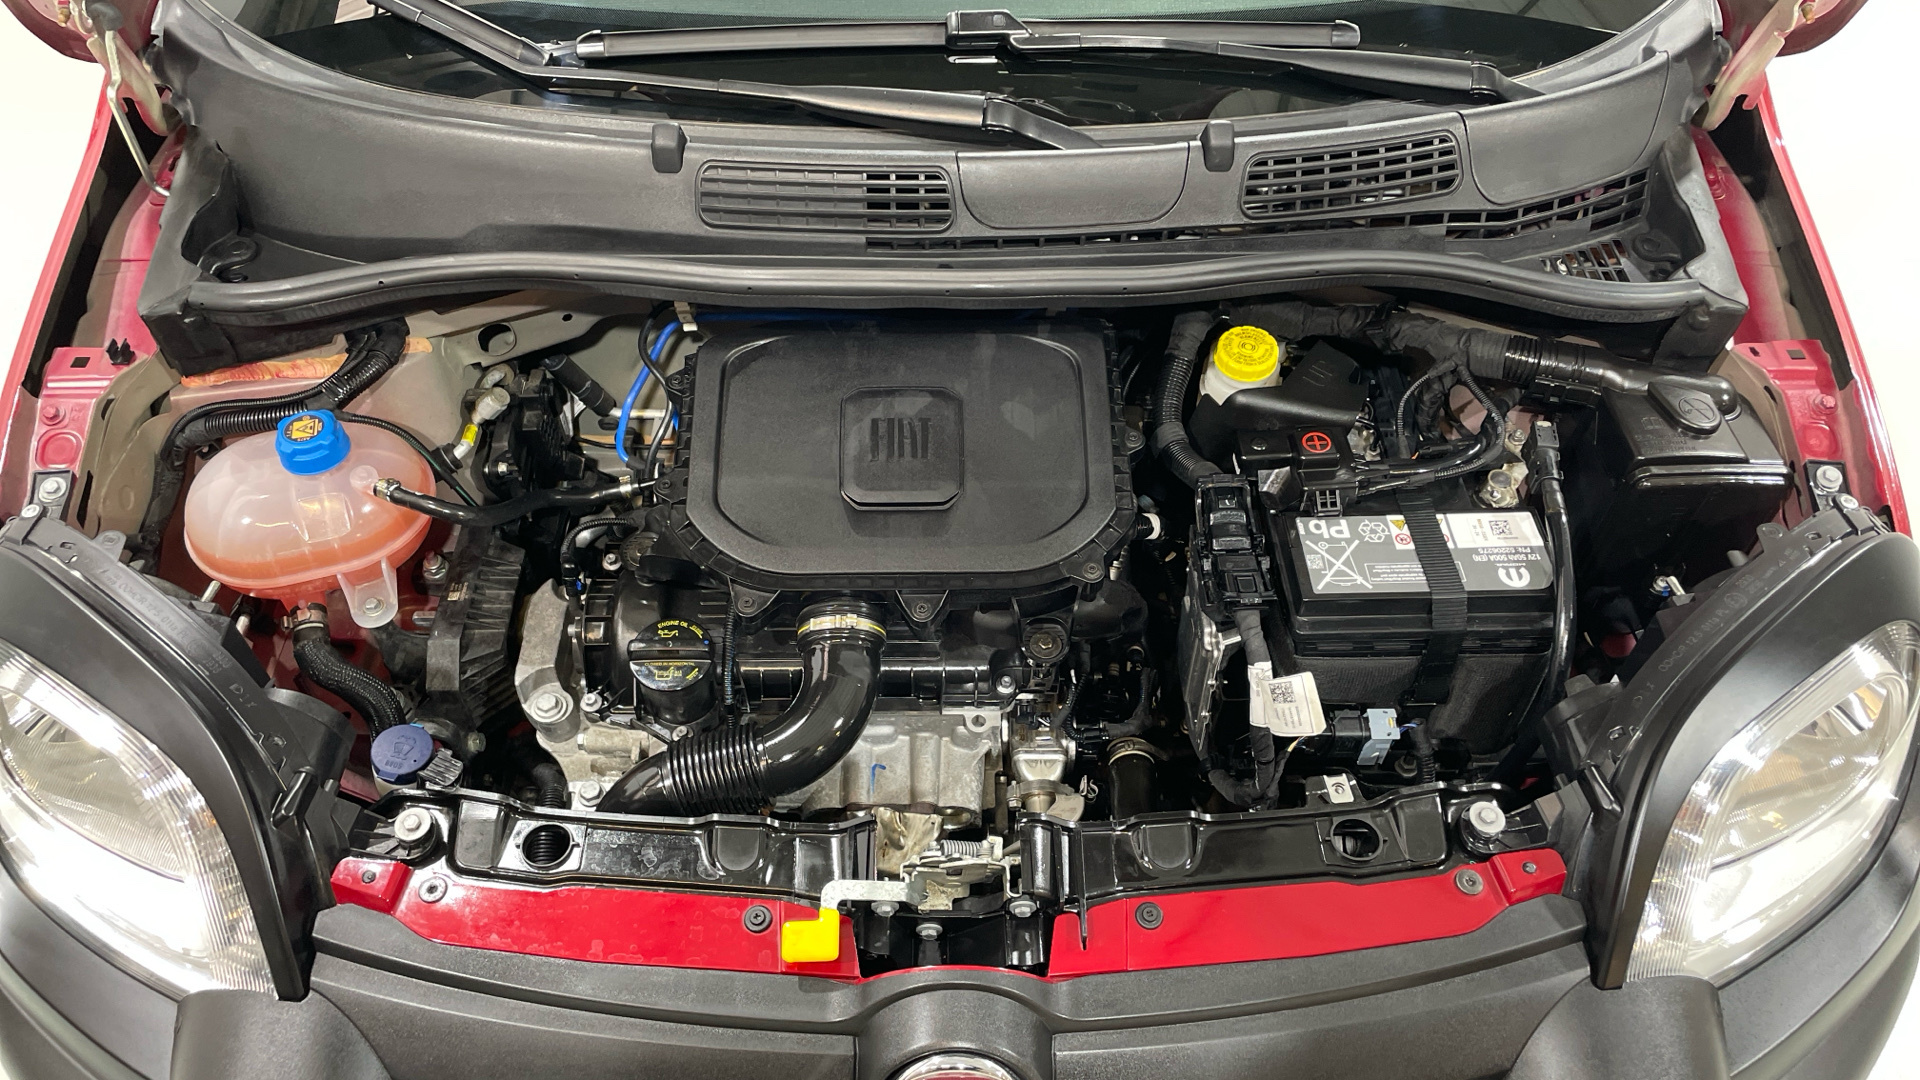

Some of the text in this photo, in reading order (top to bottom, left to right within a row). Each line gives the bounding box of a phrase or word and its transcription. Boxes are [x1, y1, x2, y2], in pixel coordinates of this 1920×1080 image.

[870, 417, 932, 462] FIAT
[1308, 519, 1351, 539] Pb
[1508, 553, 1527, 561] 50Ah
[1528, 553, 1541, 561] 12V
[657, 620, 689, 629] ENGINE OIL
